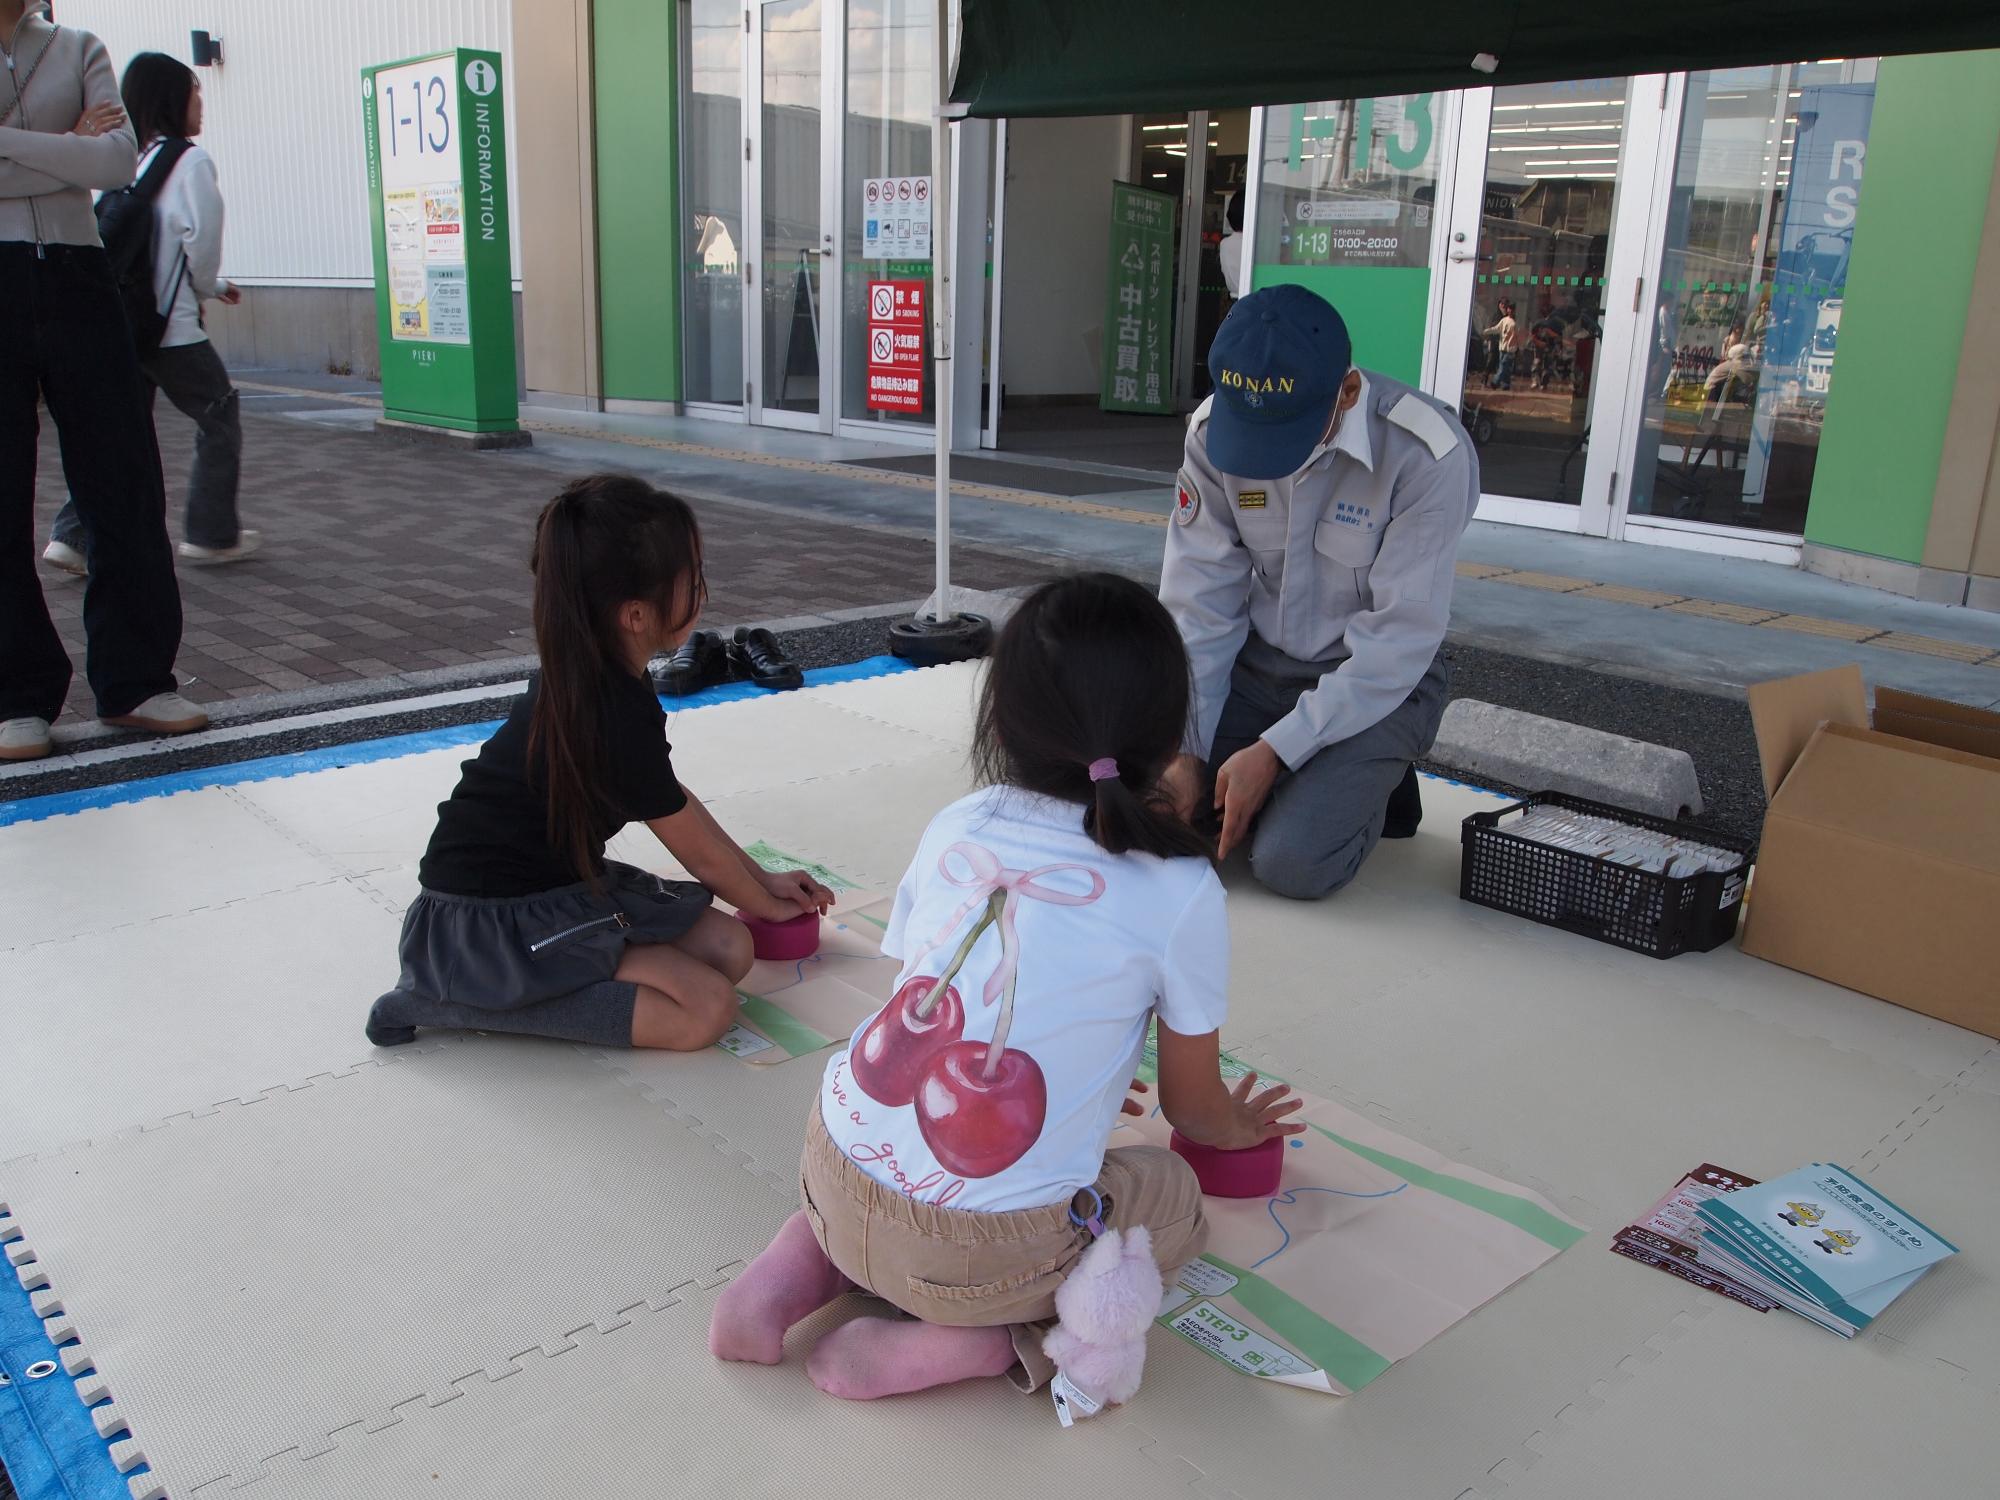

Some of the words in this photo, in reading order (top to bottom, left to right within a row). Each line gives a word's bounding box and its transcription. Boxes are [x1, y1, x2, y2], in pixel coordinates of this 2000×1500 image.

[386, 76, 450, 157] 1-13
[365, 102, 376, 188] INFORMATION
[1288, 92, 1434, 172] 1-13
[476, 103, 495, 240] INFORMATION
[1297, 233, 1328, 255] 1-13
[895, 309, 902, 317] NO
[903, 310, 920, 318] SMOKING
[1145, 242, 1161, 405] スポーツ・レジャー用品
[412, 350, 436, 361] PIERI
[894, 334, 920, 349] 火気厳禁
[1114, 283, 1142, 404] 中古買取
[894, 353, 900, 361] NO
[900, 353, 909, 362] OPEN
[909, 354, 920, 362] FLAME
[1221, 369, 1295, 394] KONAN
[870, 393, 877, 401] NO
[878, 394, 904, 404] DANGEROUS
[904, 396, 919, 405] GOODS
[850, 1111, 869, 1125] a
[850, 1143, 945, 1201] good
[1824, 1177, 1923, 1248] 予防救急のすすめ
[1183, 1317, 1224, 1343] AEDをPUSH
[1195, 1307, 1250, 1341] STEP3
